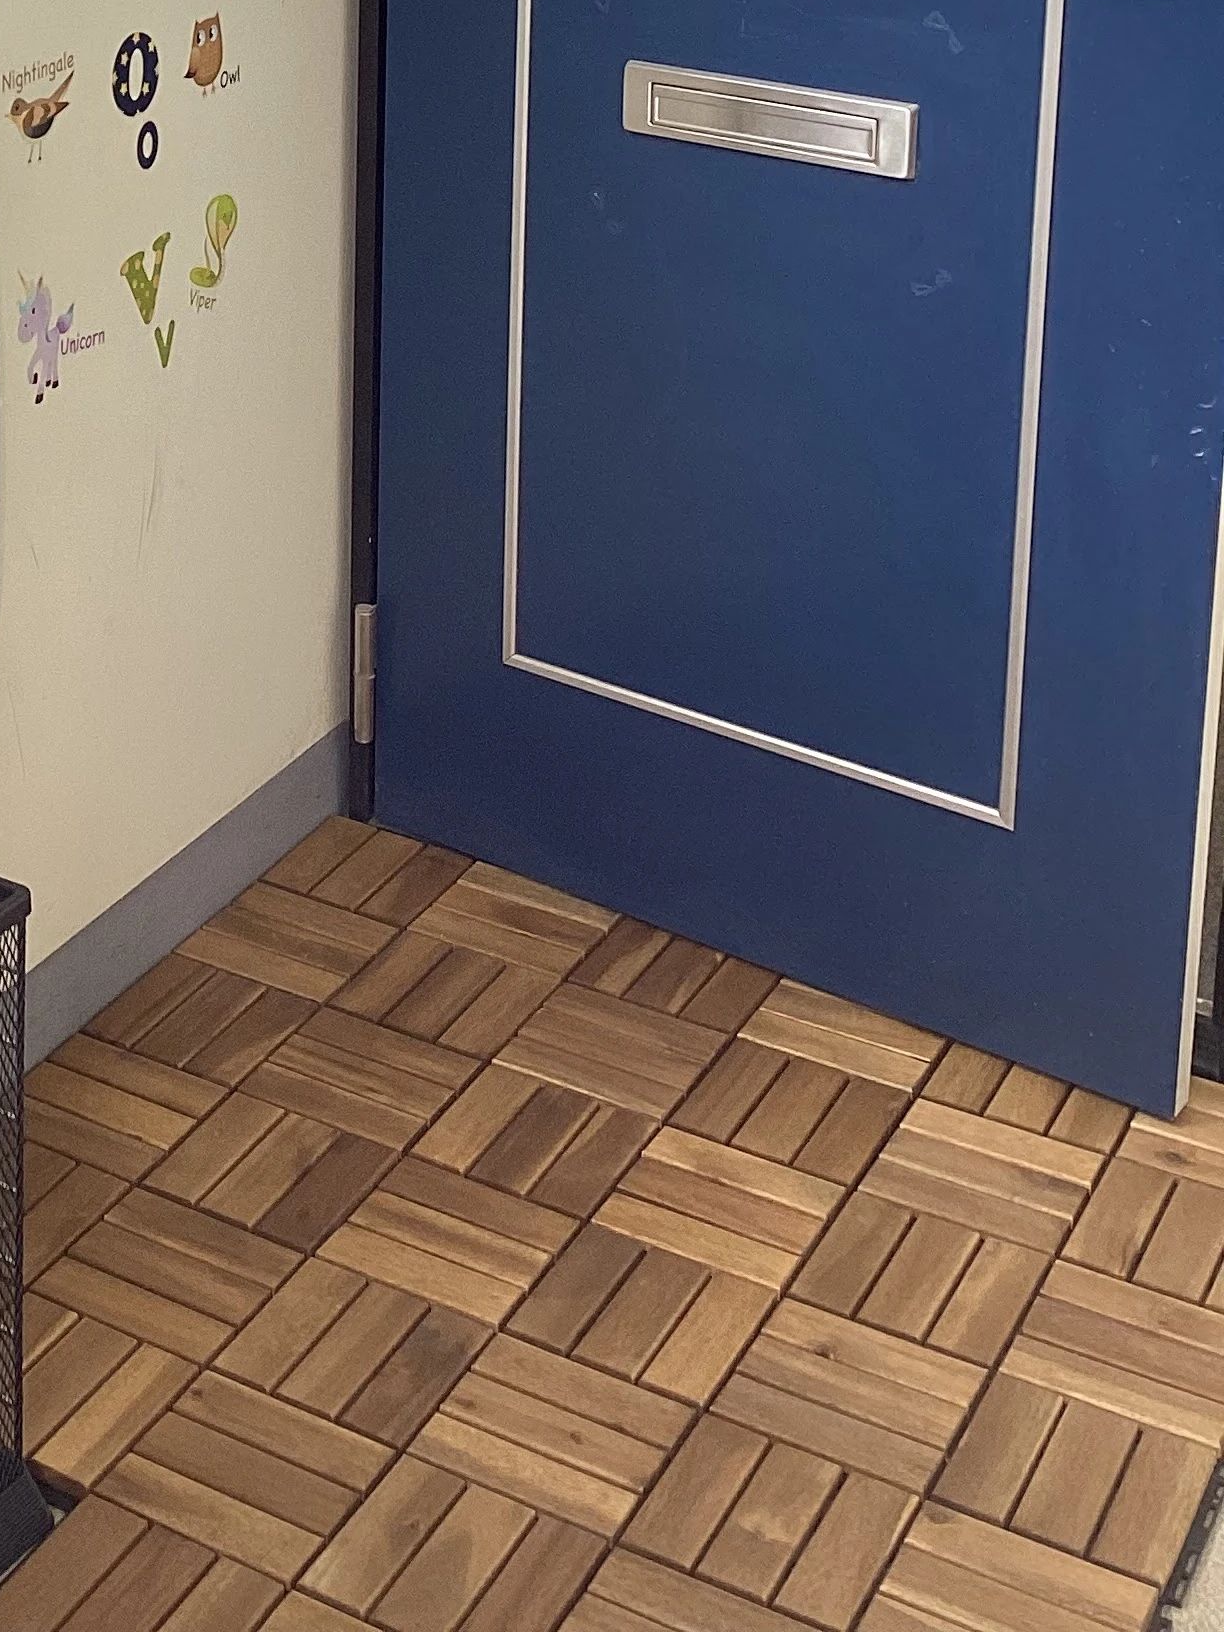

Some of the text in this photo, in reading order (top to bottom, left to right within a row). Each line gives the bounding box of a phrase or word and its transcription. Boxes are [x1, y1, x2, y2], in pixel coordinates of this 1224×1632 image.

[1, 51, 75, 94] Nightingale
[219, 64, 242, 89] Owl
[119, 231, 172, 325] V
[189, 288, 218, 312] Viper
[59, 328, 106, 356] Unicorn
